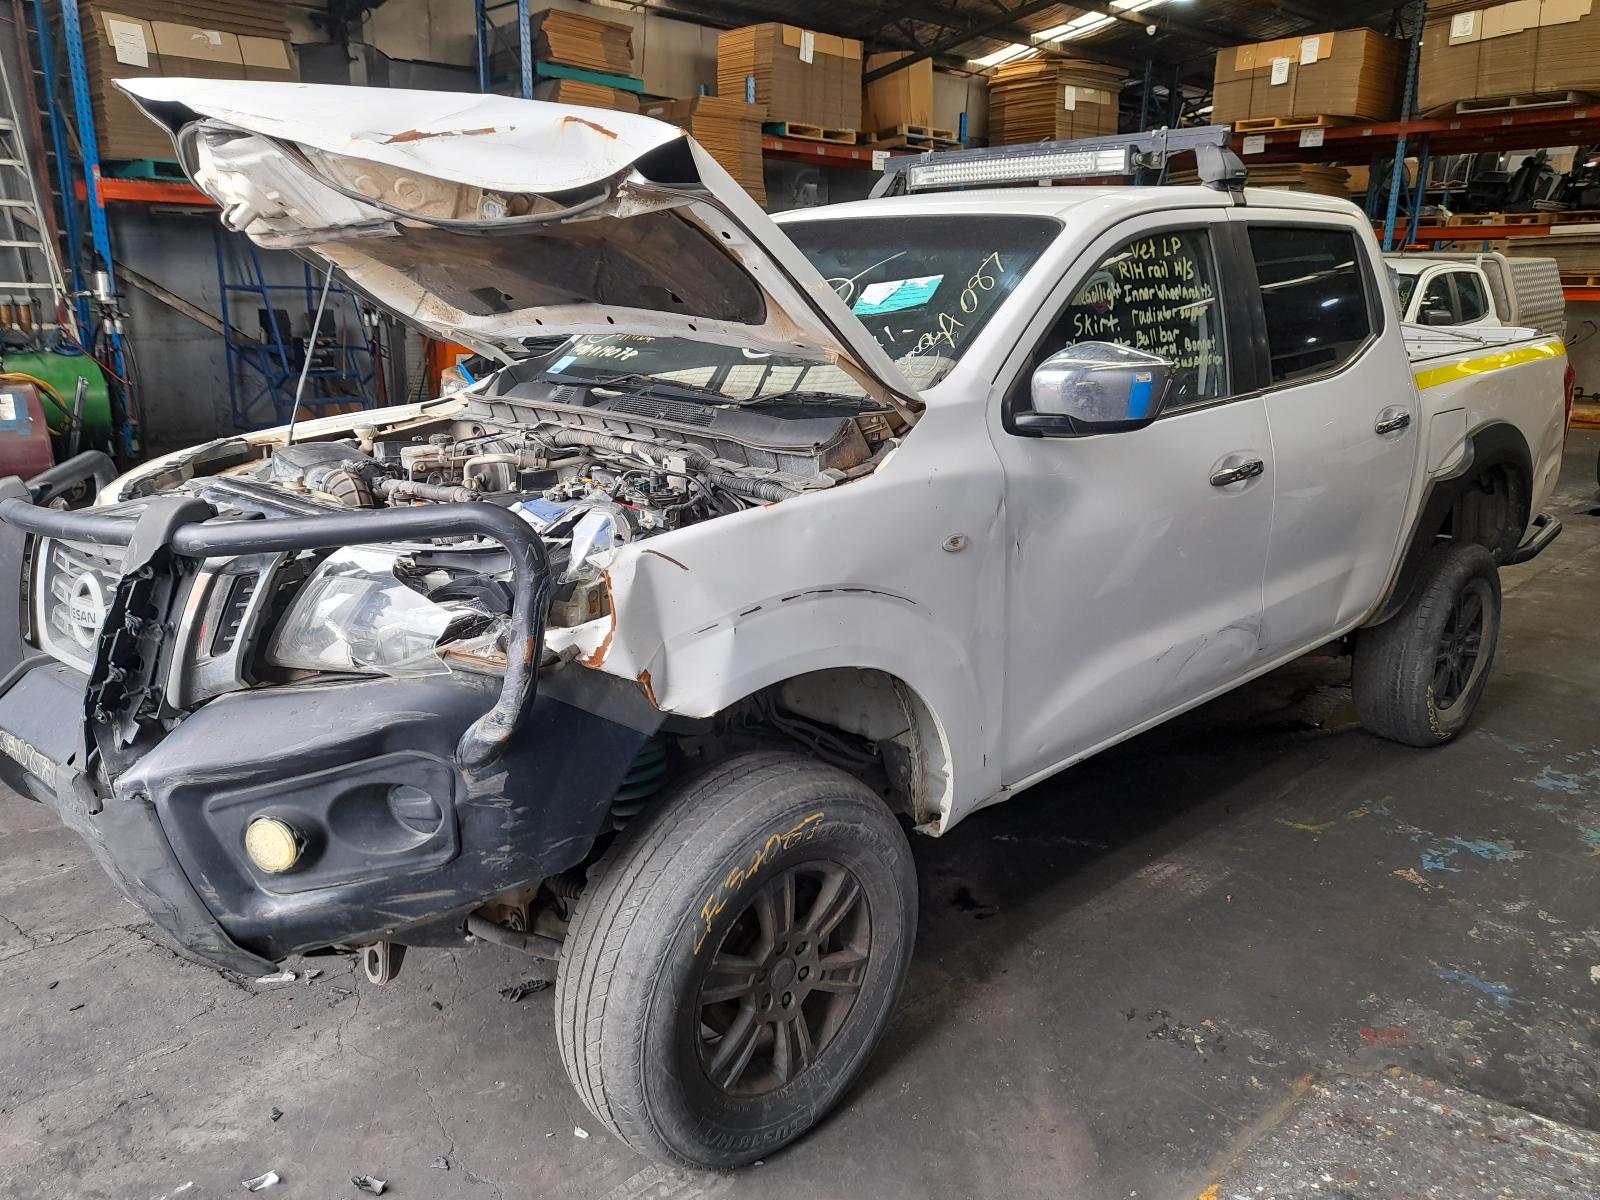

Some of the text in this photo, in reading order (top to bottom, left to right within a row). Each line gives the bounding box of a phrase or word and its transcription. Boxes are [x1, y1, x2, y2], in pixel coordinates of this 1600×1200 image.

[1148, 260, 1169, 279] rail
[1159, 325, 1180, 343] bar
[71, 607, 97, 624] SSAN
